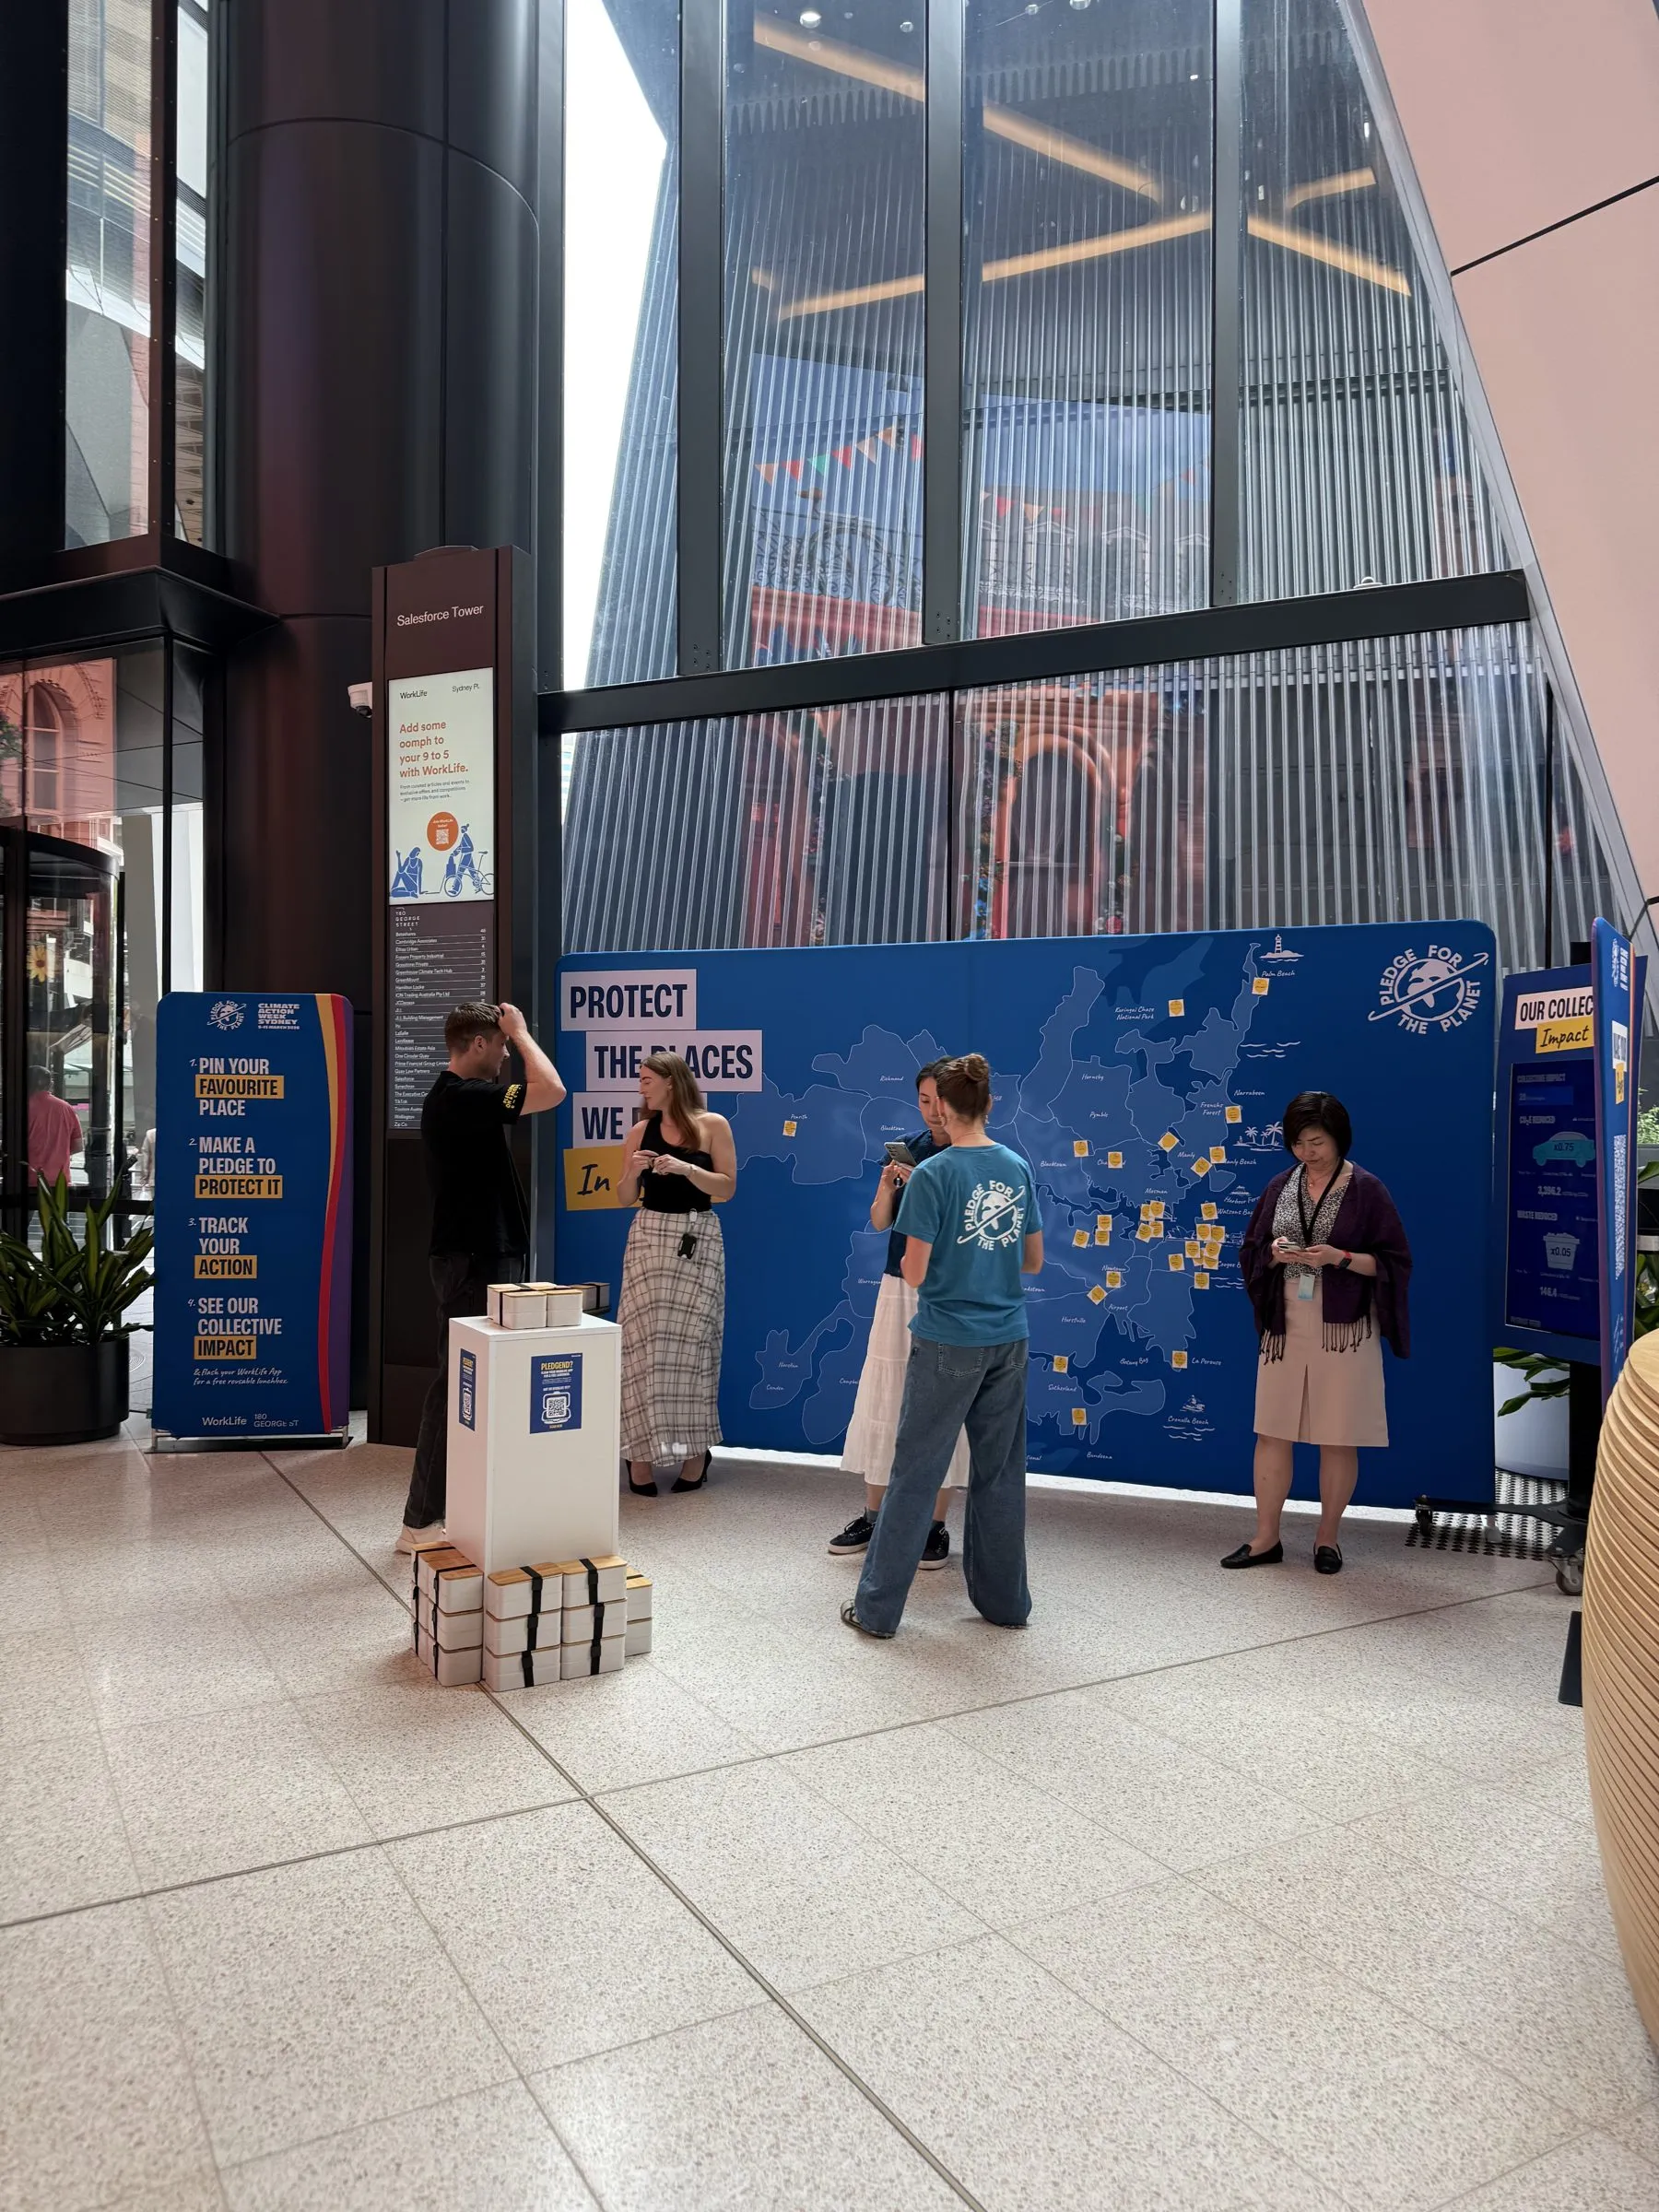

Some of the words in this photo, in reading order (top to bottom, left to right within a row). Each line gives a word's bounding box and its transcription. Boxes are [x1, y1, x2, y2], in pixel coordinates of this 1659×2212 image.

[397, 611, 450, 626] Salesforce
[452, 606, 484, 618] Tower
[400, 690, 428, 699] WorkLife
[452, 685, 473, 693] Sydney
[400, 723, 418, 734] Add
[421, 722, 446, 732] some
[400, 736, 431, 748] oomph
[435, 736, 444, 745] to
[400, 754, 420, 766] your
[423, 751, 429, 760] 9
[431, 752, 441, 760] to
[443, 750, 450, 759] 5
[400, 767, 419, 778] with
[422, 763, 468, 775] WorkLife.
[1379, 948, 1418, 1006] PLEDGE
[1429, 945, 1463, 968] FOR
[227, 1000, 239, 1008] FOR
[570, 983, 688, 1018] PROTECT
[1397, 1014, 1429, 1034] THE
[1440, 980, 1481, 1032] PLANET
[1520, 1000, 1545, 1022] OUR
[1540, 1025, 1590, 1049] Impact
[199, 1057, 225, 1075] PIN
[229, 1058, 270, 1075] YOUR
[594, 1045, 642, 1078] THE
[199, 1078, 277, 1095] FAVOURITE
[199, 1100, 245, 1116] PLACE
[582, 1107, 623, 1140] WE
[199, 1136, 241, 1153] MAKE
[245, 1136, 255, 1153] A
[1554, 1142, 1575, 1152] x0.75
[1177, 1151, 1195, 1159] Manly
[199, 1158, 253, 1174] PLEDGE
[257, 1158, 276, 1174] TO
[199, 1179, 264, 1195] PROTECT
[267, 1179, 280, 1195] IT
[576, 1163, 610, 1195] In
[964, 1183, 985, 1231] PLEDGE
[989, 1180, 1014, 1197] FOR
[1224, 1196, 1246, 1205] Harbour
[199, 1217, 249, 1233] TRACK
[977, 1236, 995, 1251] THE
[1001, 1206, 1025, 1248] PLANET
[199, 1238, 240, 1254] YOUR
[1550, 1246, 1571, 1257] x0.05
[199, 1259, 253, 1276] ACTION
[198, 1298, 223, 1314] SEE
[228, 1298, 259, 1314] OUR
[198, 1318, 282, 1335] COLLECTIVE
[198, 1339, 253, 1356] IMPACT
[237, 1368, 267, 1376] WorkLife
[268, 1368, 282, 1377] App
[541, 1360, 573, 1371] PLEDGEND?
[202, 1416, 247, 1426] WorkLife
